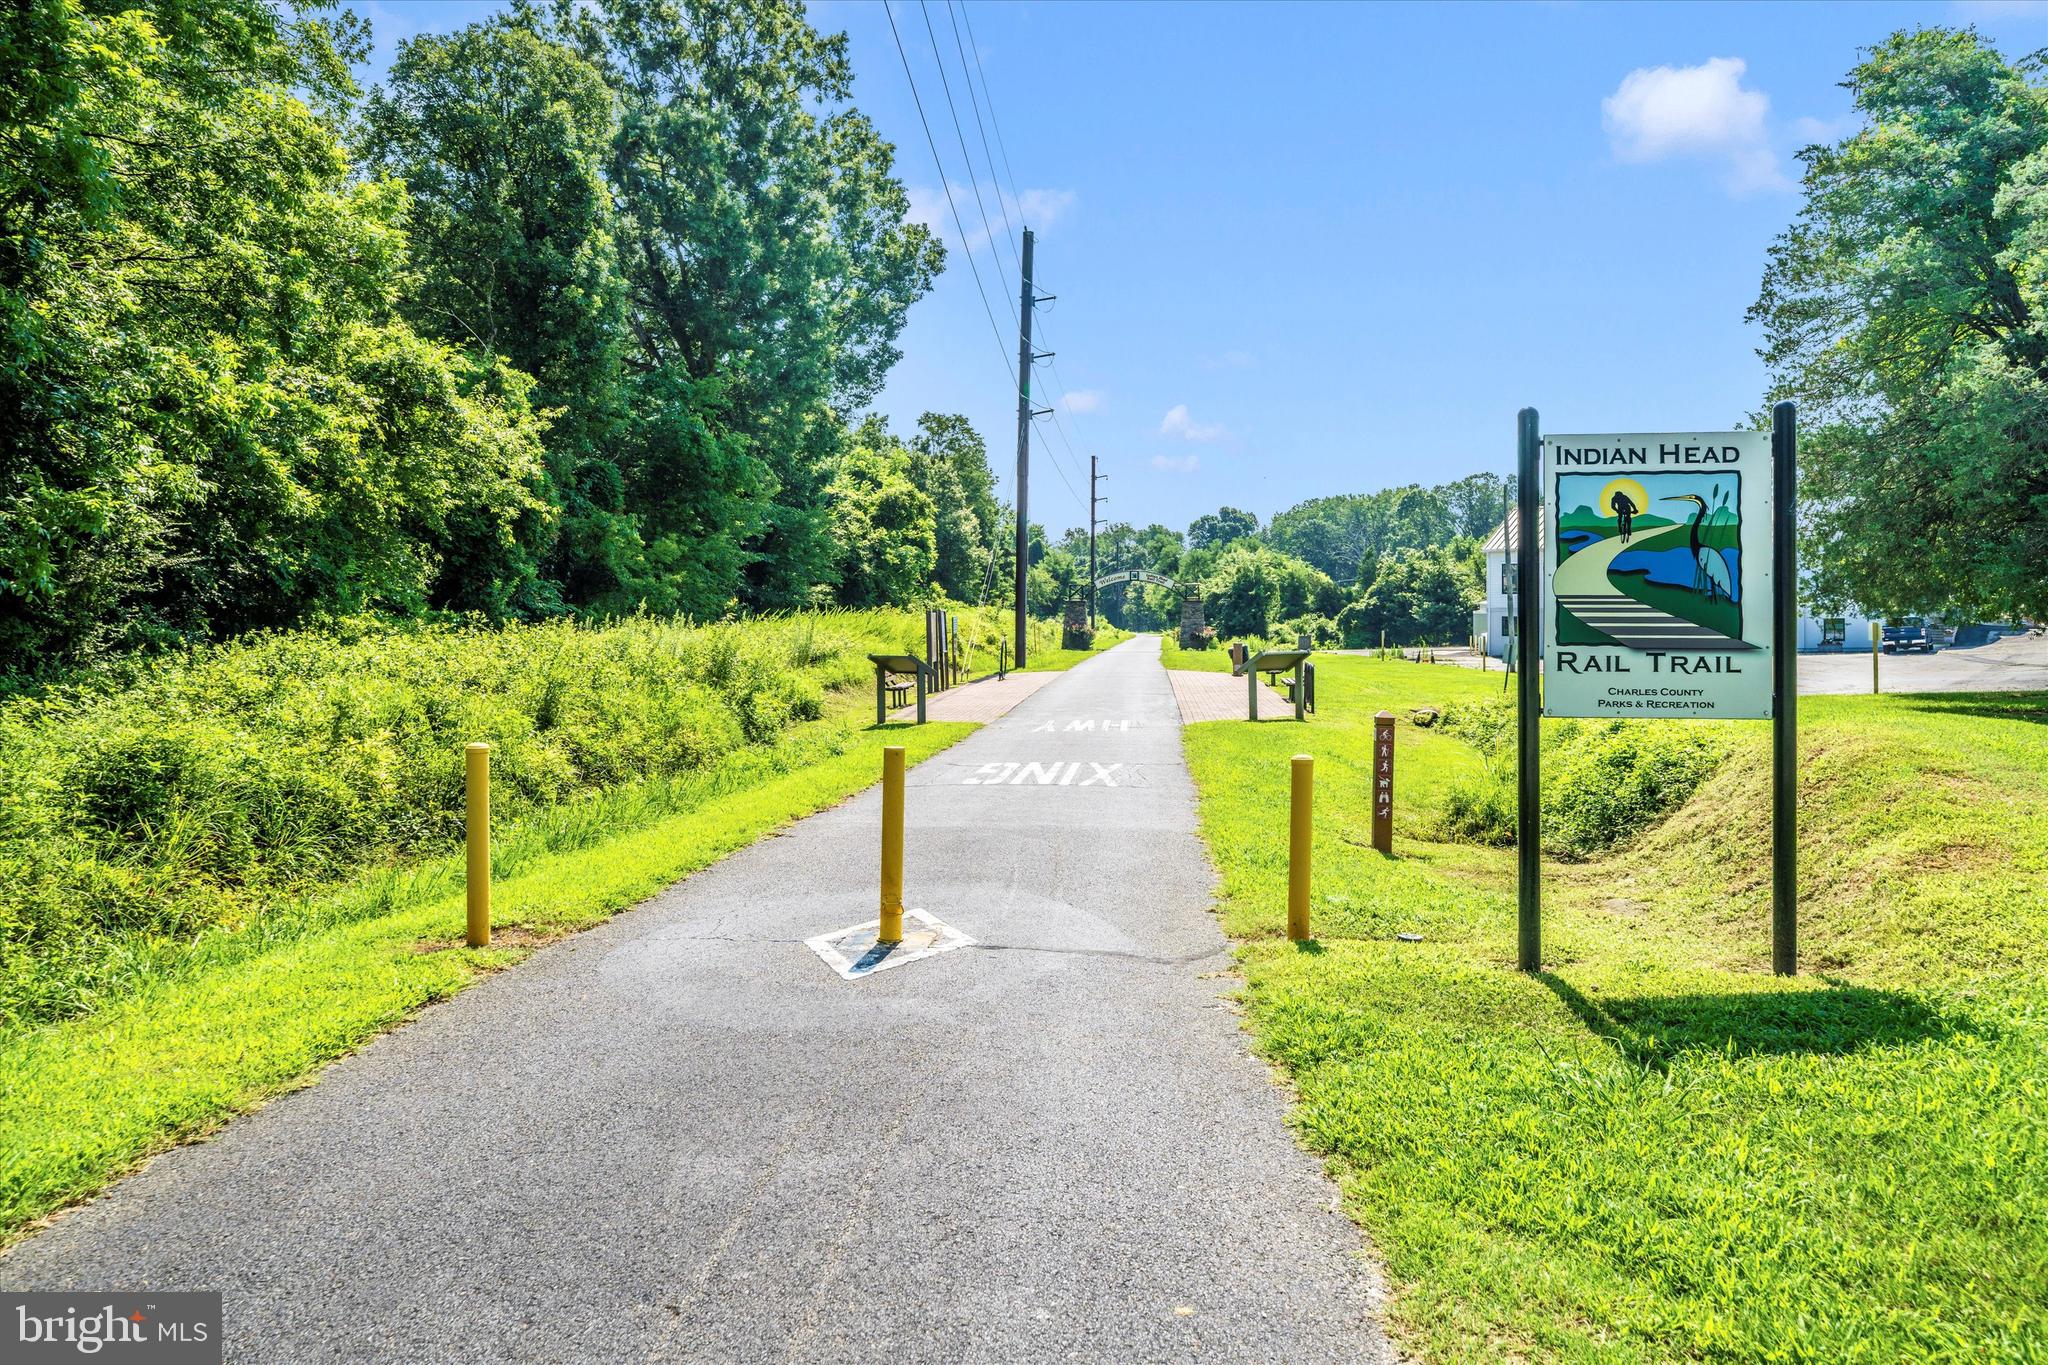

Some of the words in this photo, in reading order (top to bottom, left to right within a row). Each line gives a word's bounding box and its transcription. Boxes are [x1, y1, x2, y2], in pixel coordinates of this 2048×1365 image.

[1555, 445, 1647, 465] INDIAN
[1659, 444, 1741, 464] HEAD
[1100, 575, 1126, 585] Welcome
[1556, 651, 1631, 675] RAIL
[1646, 651, 1742, 675] TRAIL
[1608, 687, 1658, 696] CHARLES
[1660, 688, 1704, 696] COUNTY
[1598, 699, 1633, 708] PARKS
[1635, 700, 1644, 708] &
[1646, 699, 1715, 709] RECREATION
[1033, 719, 1131, 732] HWY
[962, 761, 1123, 787] XING
